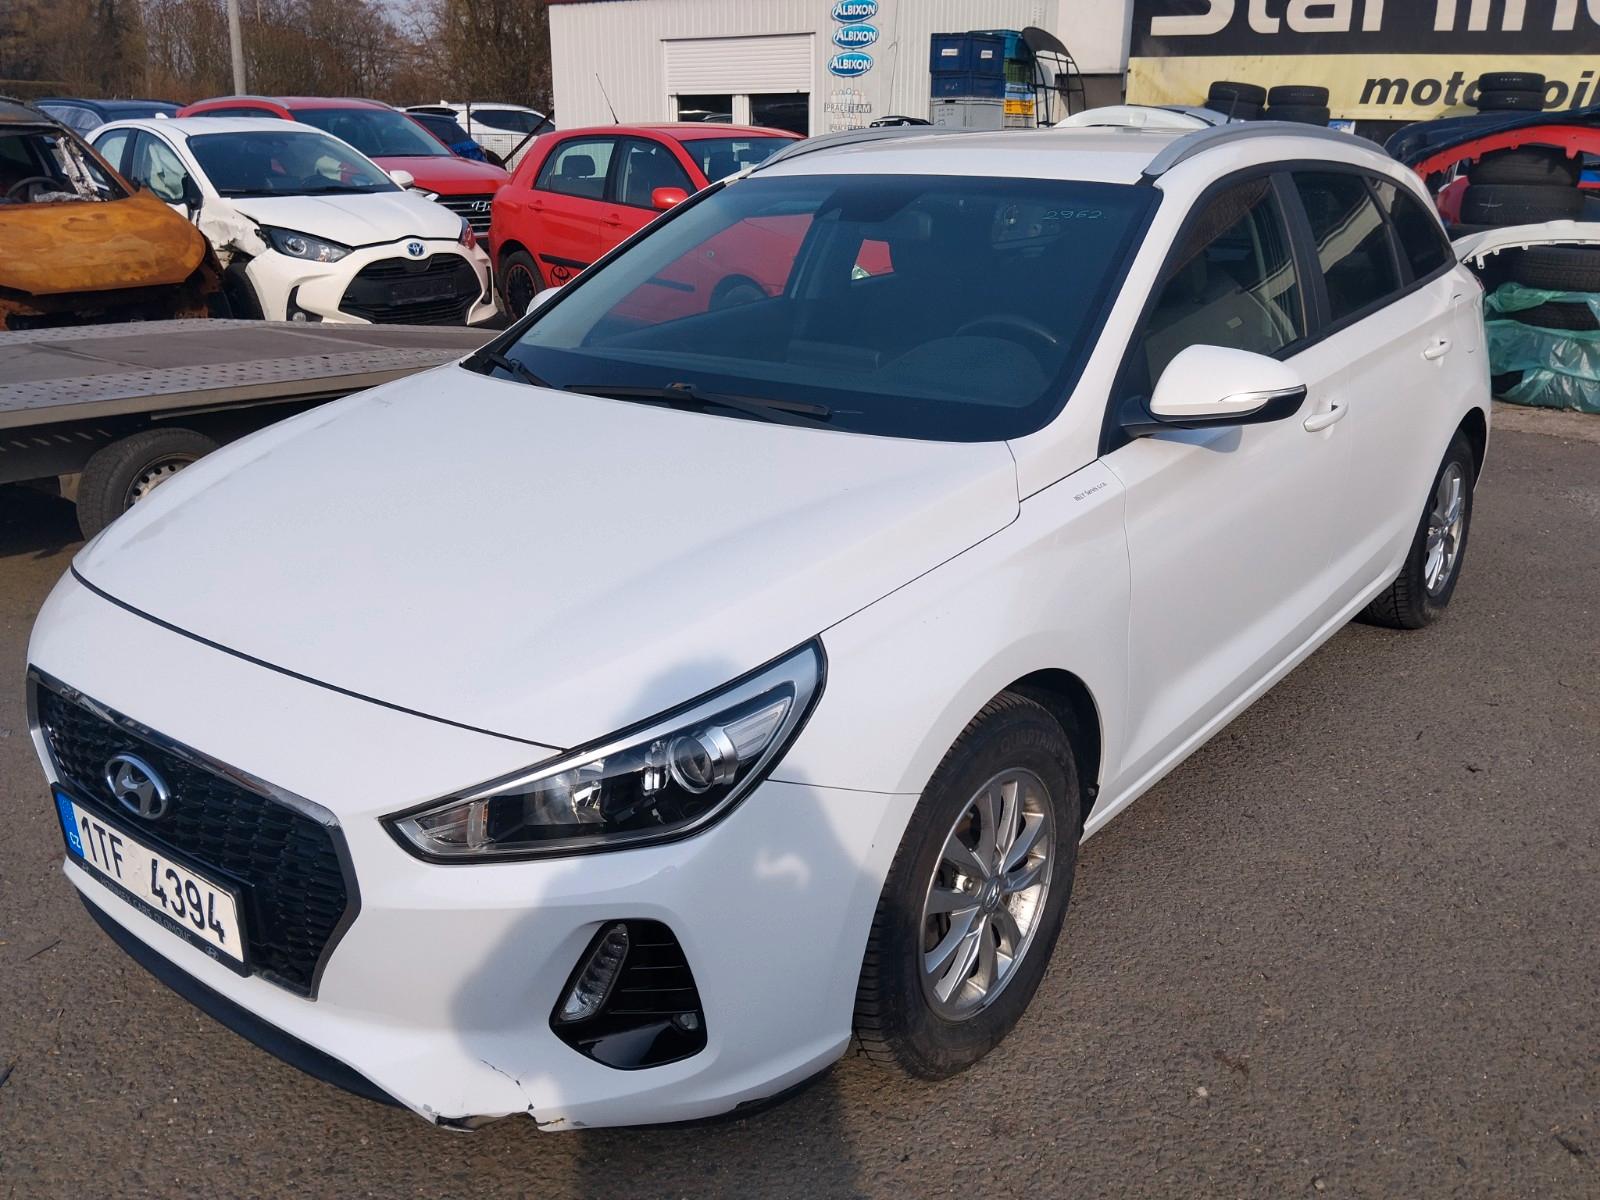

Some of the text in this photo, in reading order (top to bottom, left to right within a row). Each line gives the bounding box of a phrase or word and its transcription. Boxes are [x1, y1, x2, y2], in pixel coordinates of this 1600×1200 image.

[834, 4, 876, 16] ALBIXON
[836, 27, 876, 42] ALBIXON
[831, 55, 871, 70] ALBIXON
[69, 831, 81, 849] CZ
[81, 815, 225, 945] 1TF 4394
